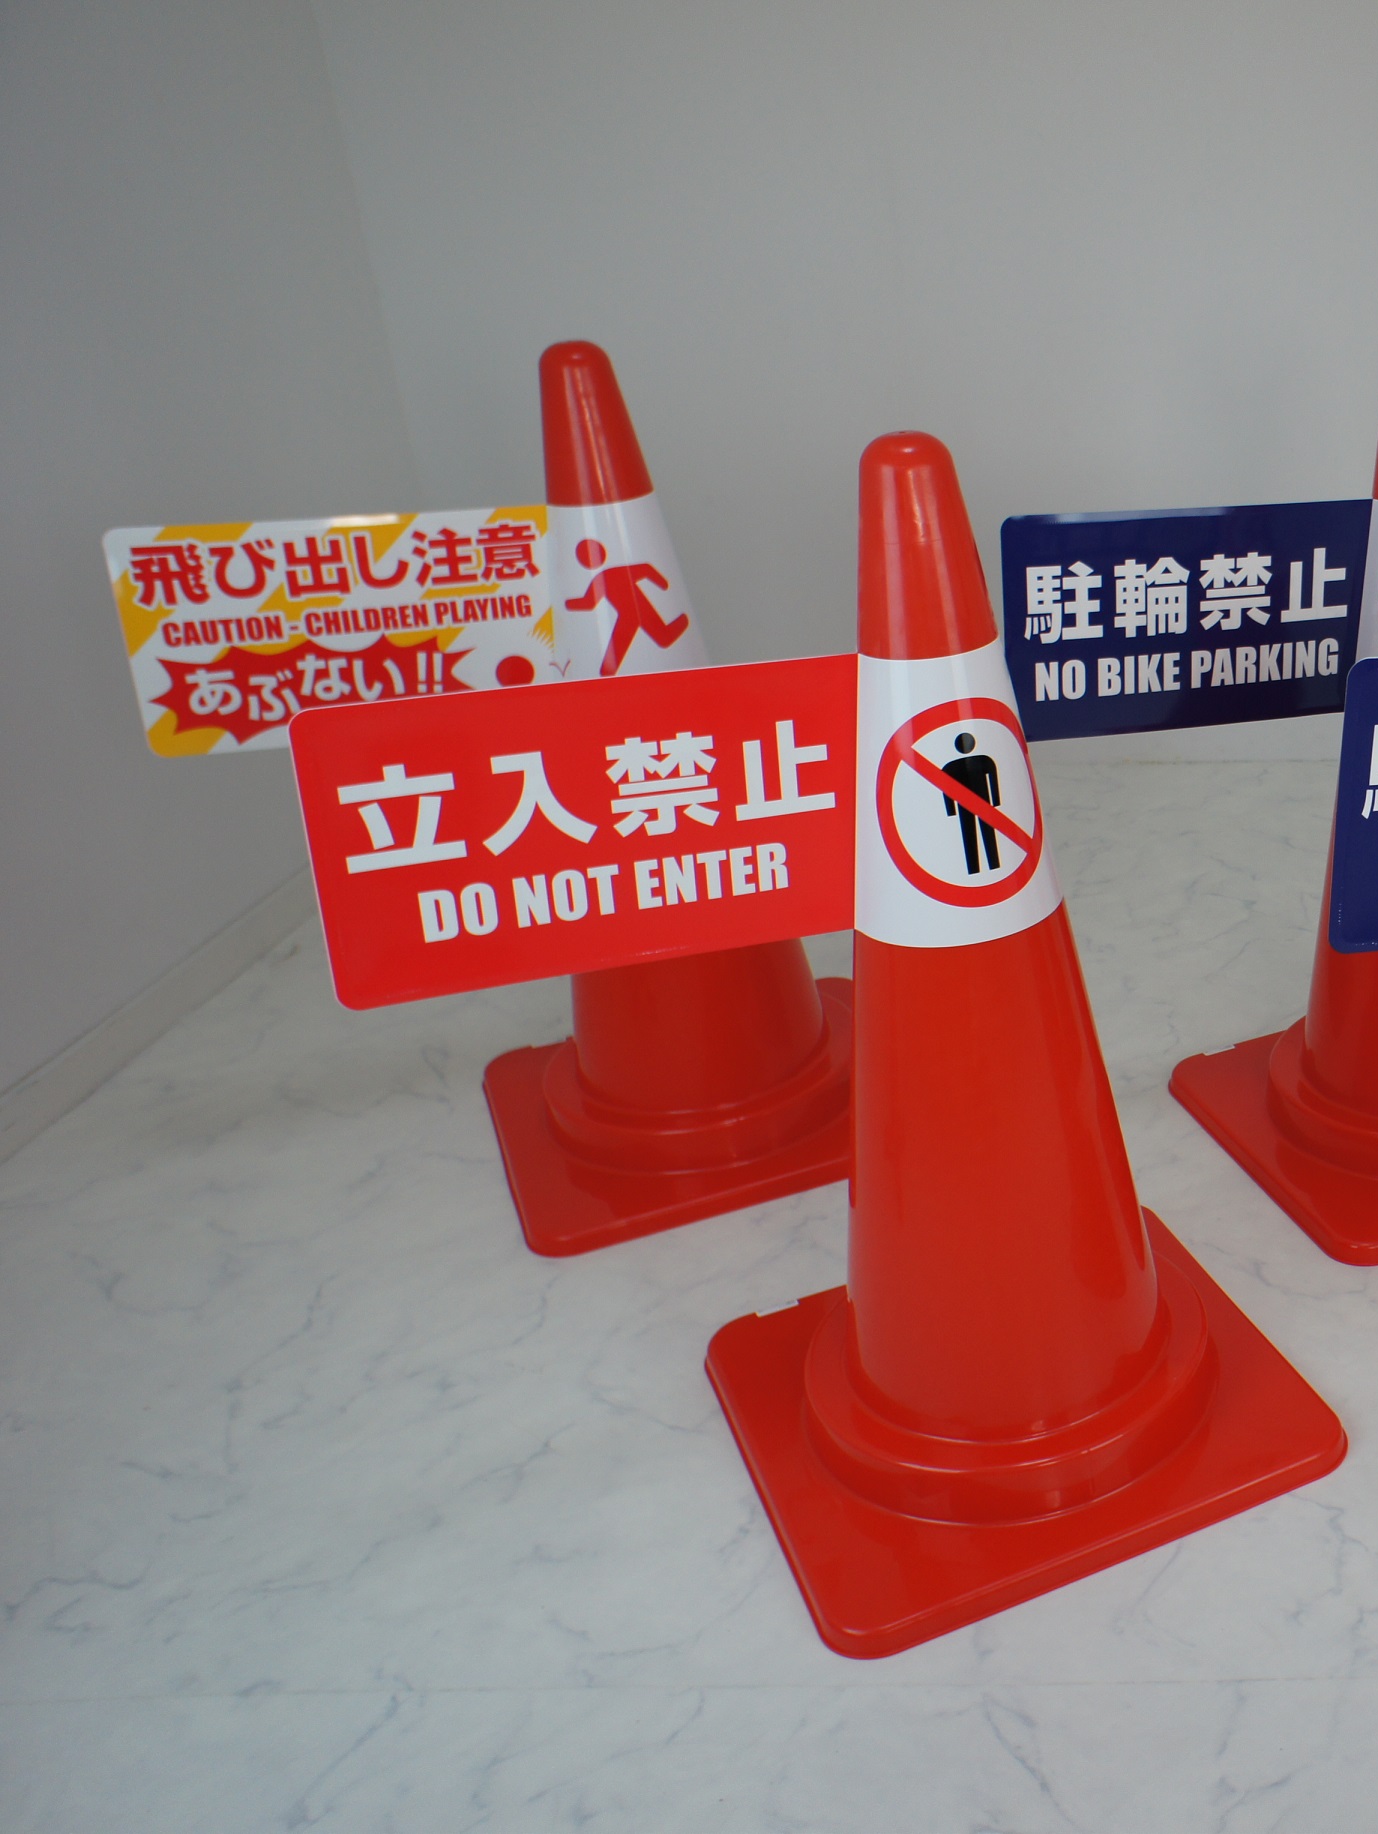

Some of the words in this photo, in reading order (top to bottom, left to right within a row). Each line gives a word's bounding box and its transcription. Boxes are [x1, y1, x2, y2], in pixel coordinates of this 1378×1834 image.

[129, 523, 541, 606] 飛び出し注意
[1023, 547, 1349, 644] 駐輪禁止
[162, 615, 284, 648] CAUTION
[305, 600, 430, 637] CHILDREN
[436, 594, 532, 626] PLAYING
[1034, 659, 1086, 702] NO
[1098, 652, 1181, 698] BIKE
[1190, 638, 1339, 690] PARKING
[336, 719, 836, 875] 立入禁止
[417, 881, 499, 945] DO
[514, 864, 619, 928] NOT
[636, 842, 790, 910] ENTER
